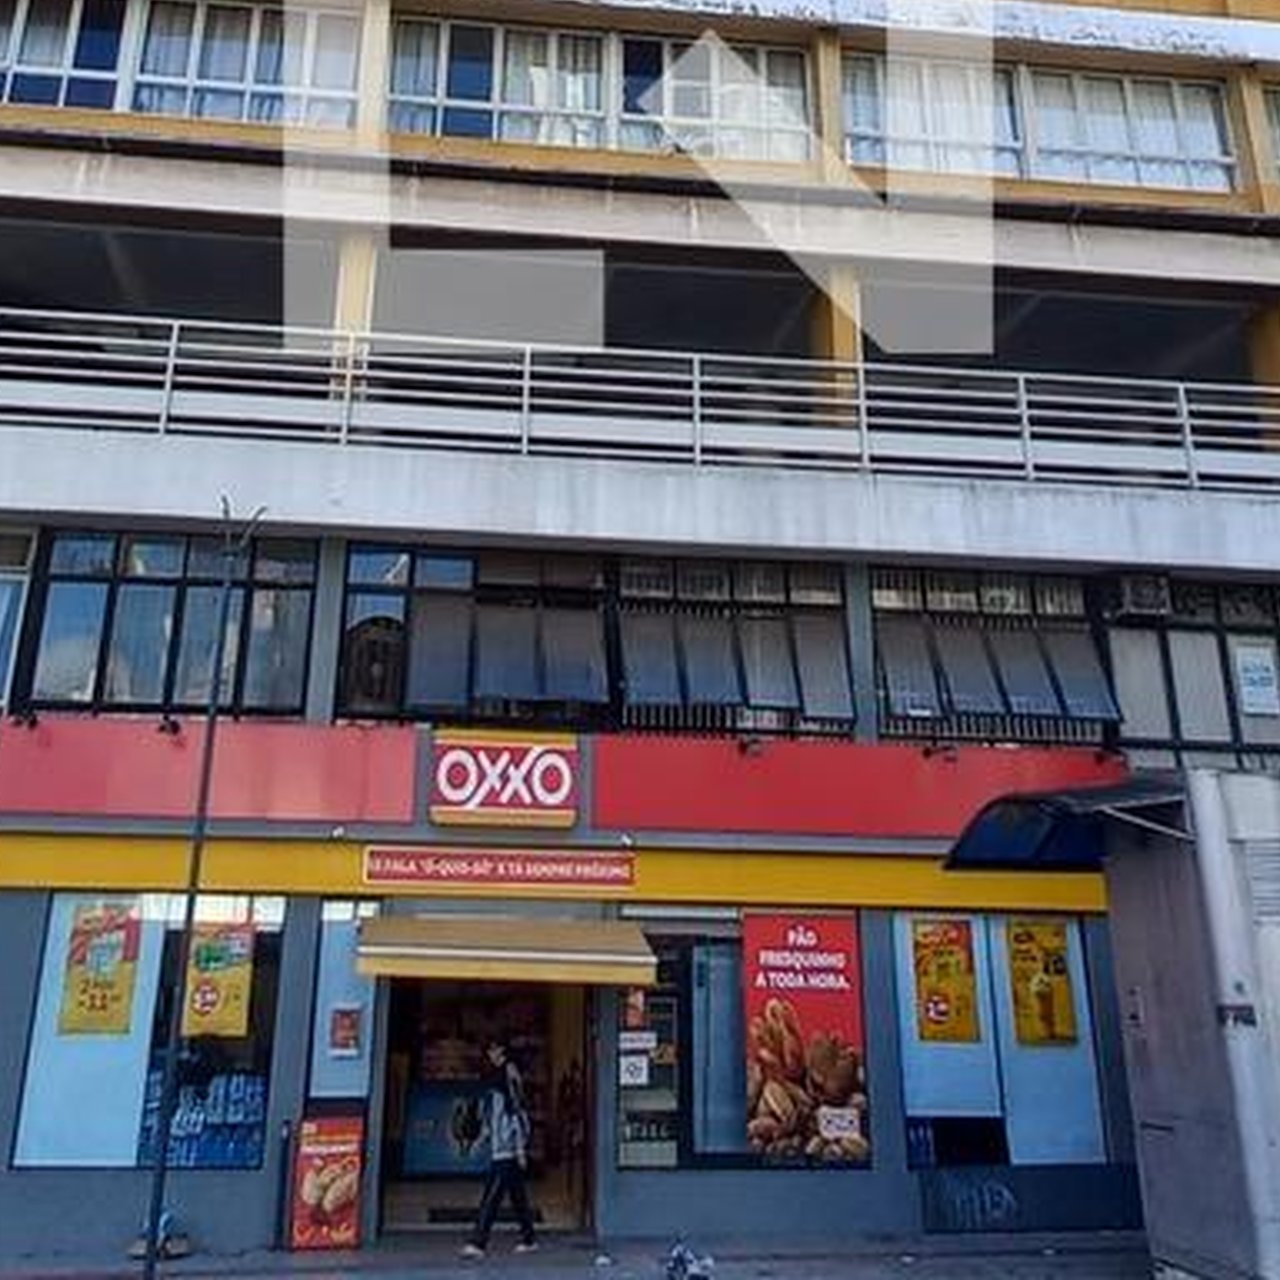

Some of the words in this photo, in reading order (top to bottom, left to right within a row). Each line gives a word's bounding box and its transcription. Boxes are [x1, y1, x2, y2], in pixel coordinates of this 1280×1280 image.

[437, 745, 572, 808] OXXO
[787, 924, 818, 946] PÃO
[755, 971, 767, 987] A
[768, 971, 807, 988] TODA
